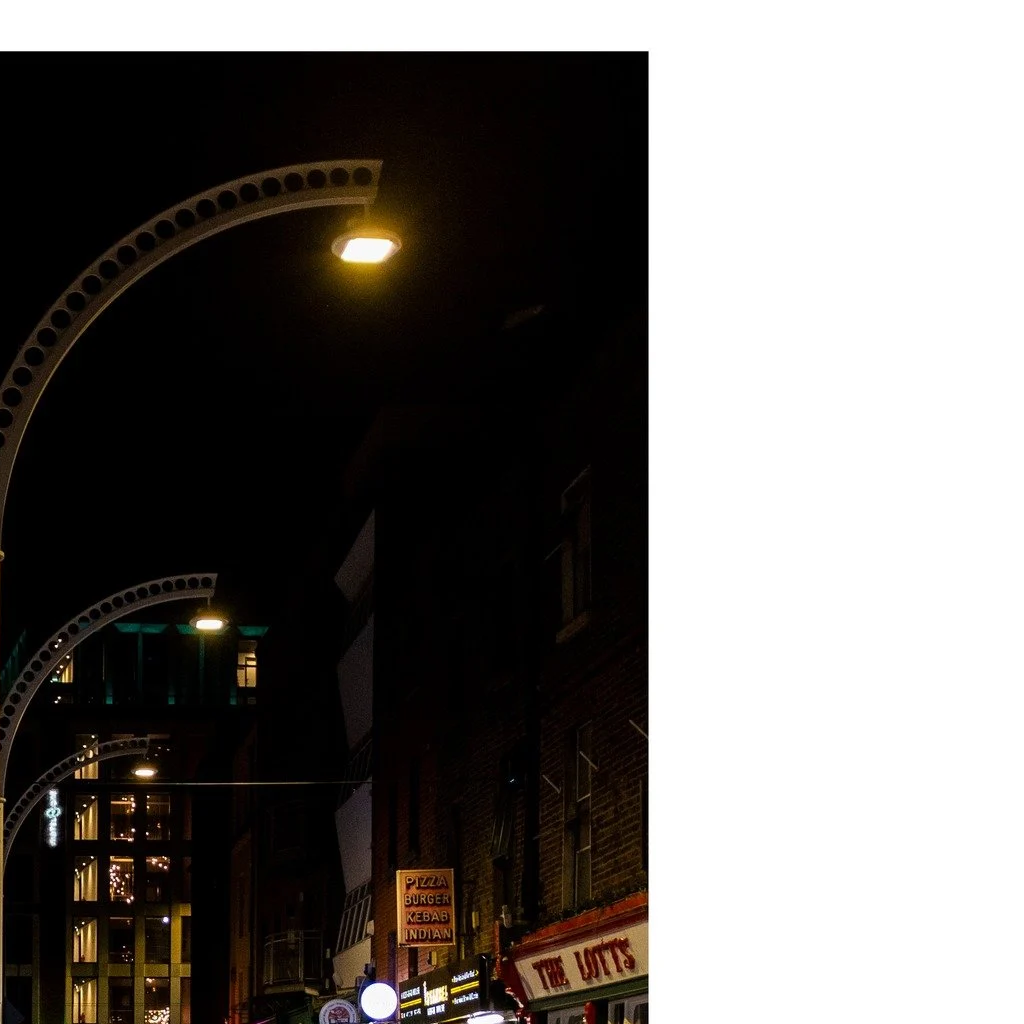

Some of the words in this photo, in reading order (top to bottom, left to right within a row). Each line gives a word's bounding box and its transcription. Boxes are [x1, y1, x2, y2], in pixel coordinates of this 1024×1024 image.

[405, 876, 447, 888] PIZZA
[404, 893, 450, 905] BURGER
[406, 910, 448, 922] KEBAB
[405, 928, 452, 940] INDIAN
[531, 955, 570, 990] THE
[574, 937, 636, 981] LOTTS
